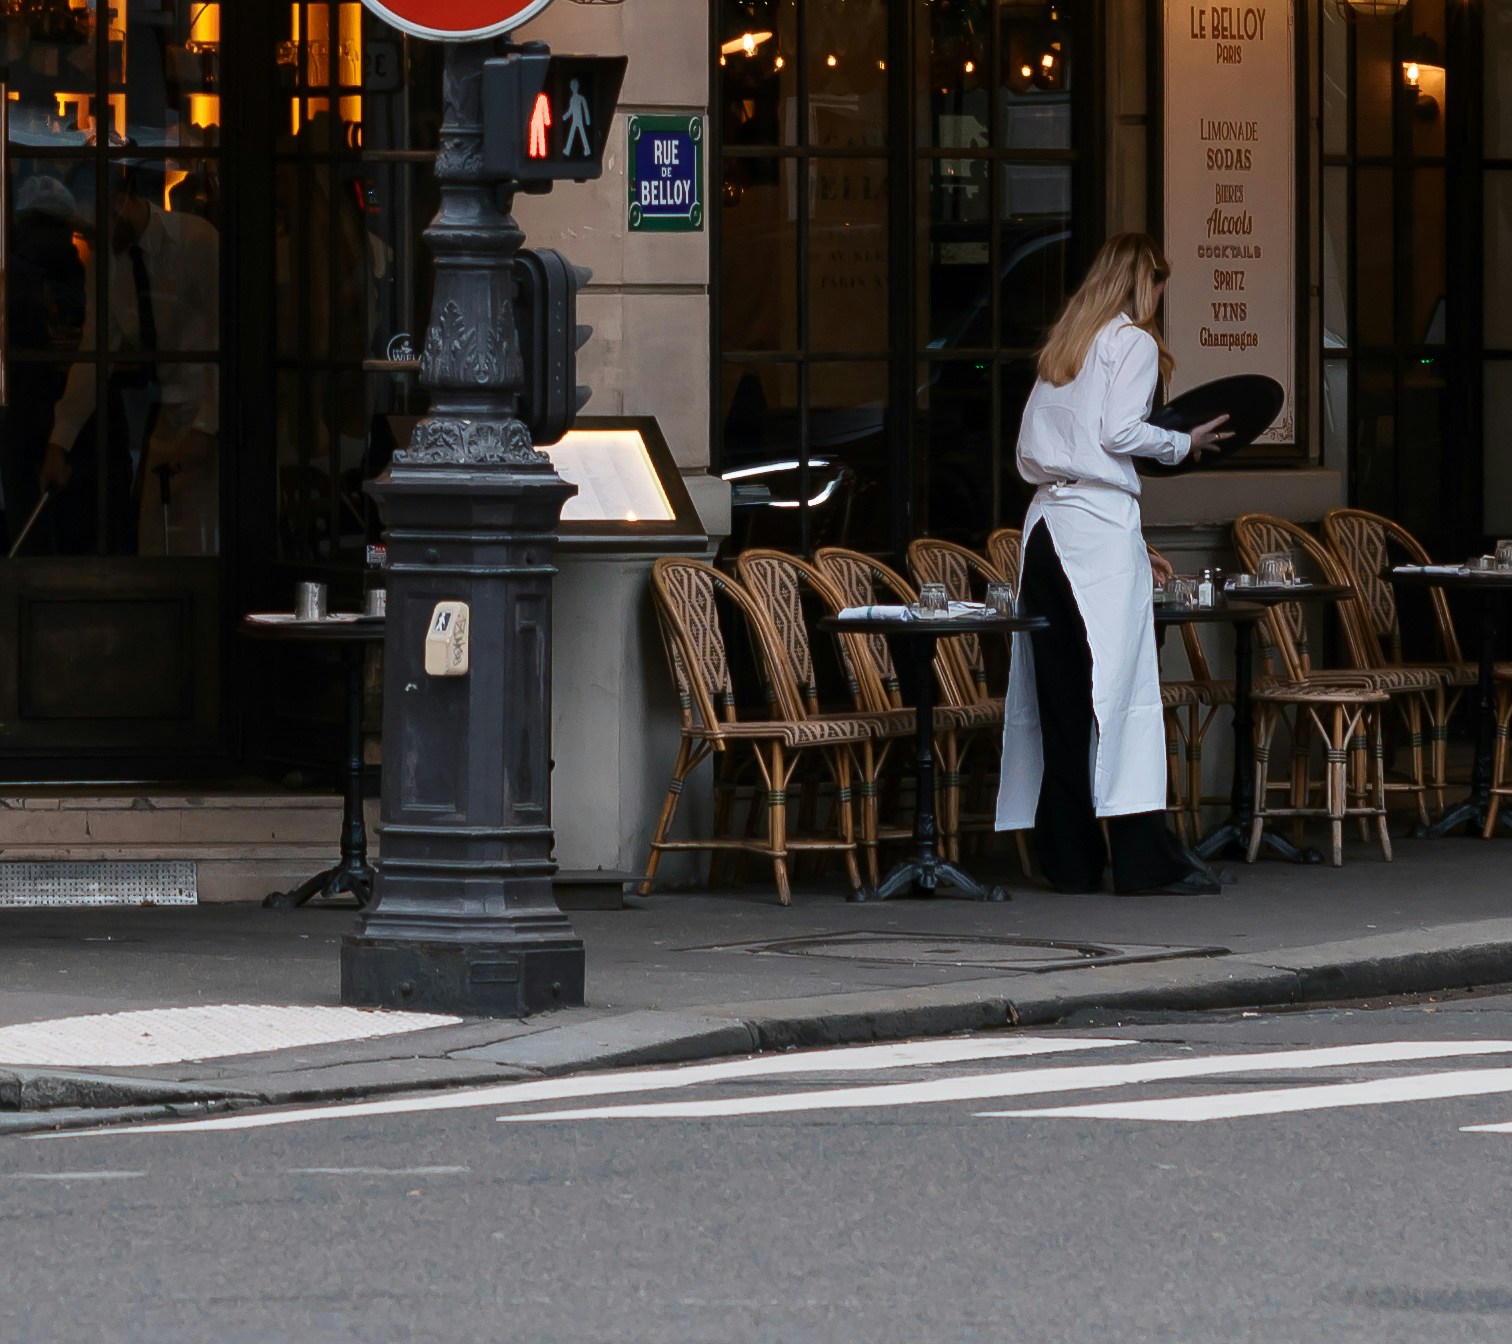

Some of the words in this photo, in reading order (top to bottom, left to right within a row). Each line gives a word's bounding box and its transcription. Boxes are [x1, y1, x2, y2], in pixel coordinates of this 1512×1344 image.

[1190, 6, 1206, 40] LE
[1211, 6, 1266, 41] BELLOY
[1216, 42, 1242, 64] PARIS
[1199, 118, 1258, 142] LIMONADE
[653, 139, 680, 165] RUE
[1206, 147, 1252, 171] SODAS
[661, 167, 673, 178] DE
[640, 179, 691, 206] BELLOY
[1207, 207, 1253, 238] Alcools
[1197, 244, 1261, 259] COCKTAILS
[1213, 269, 1245, 292] SPRITZ
[1211, 302, 1247, 321] VINS
[1199, 327, 1258, 351] Champagne
